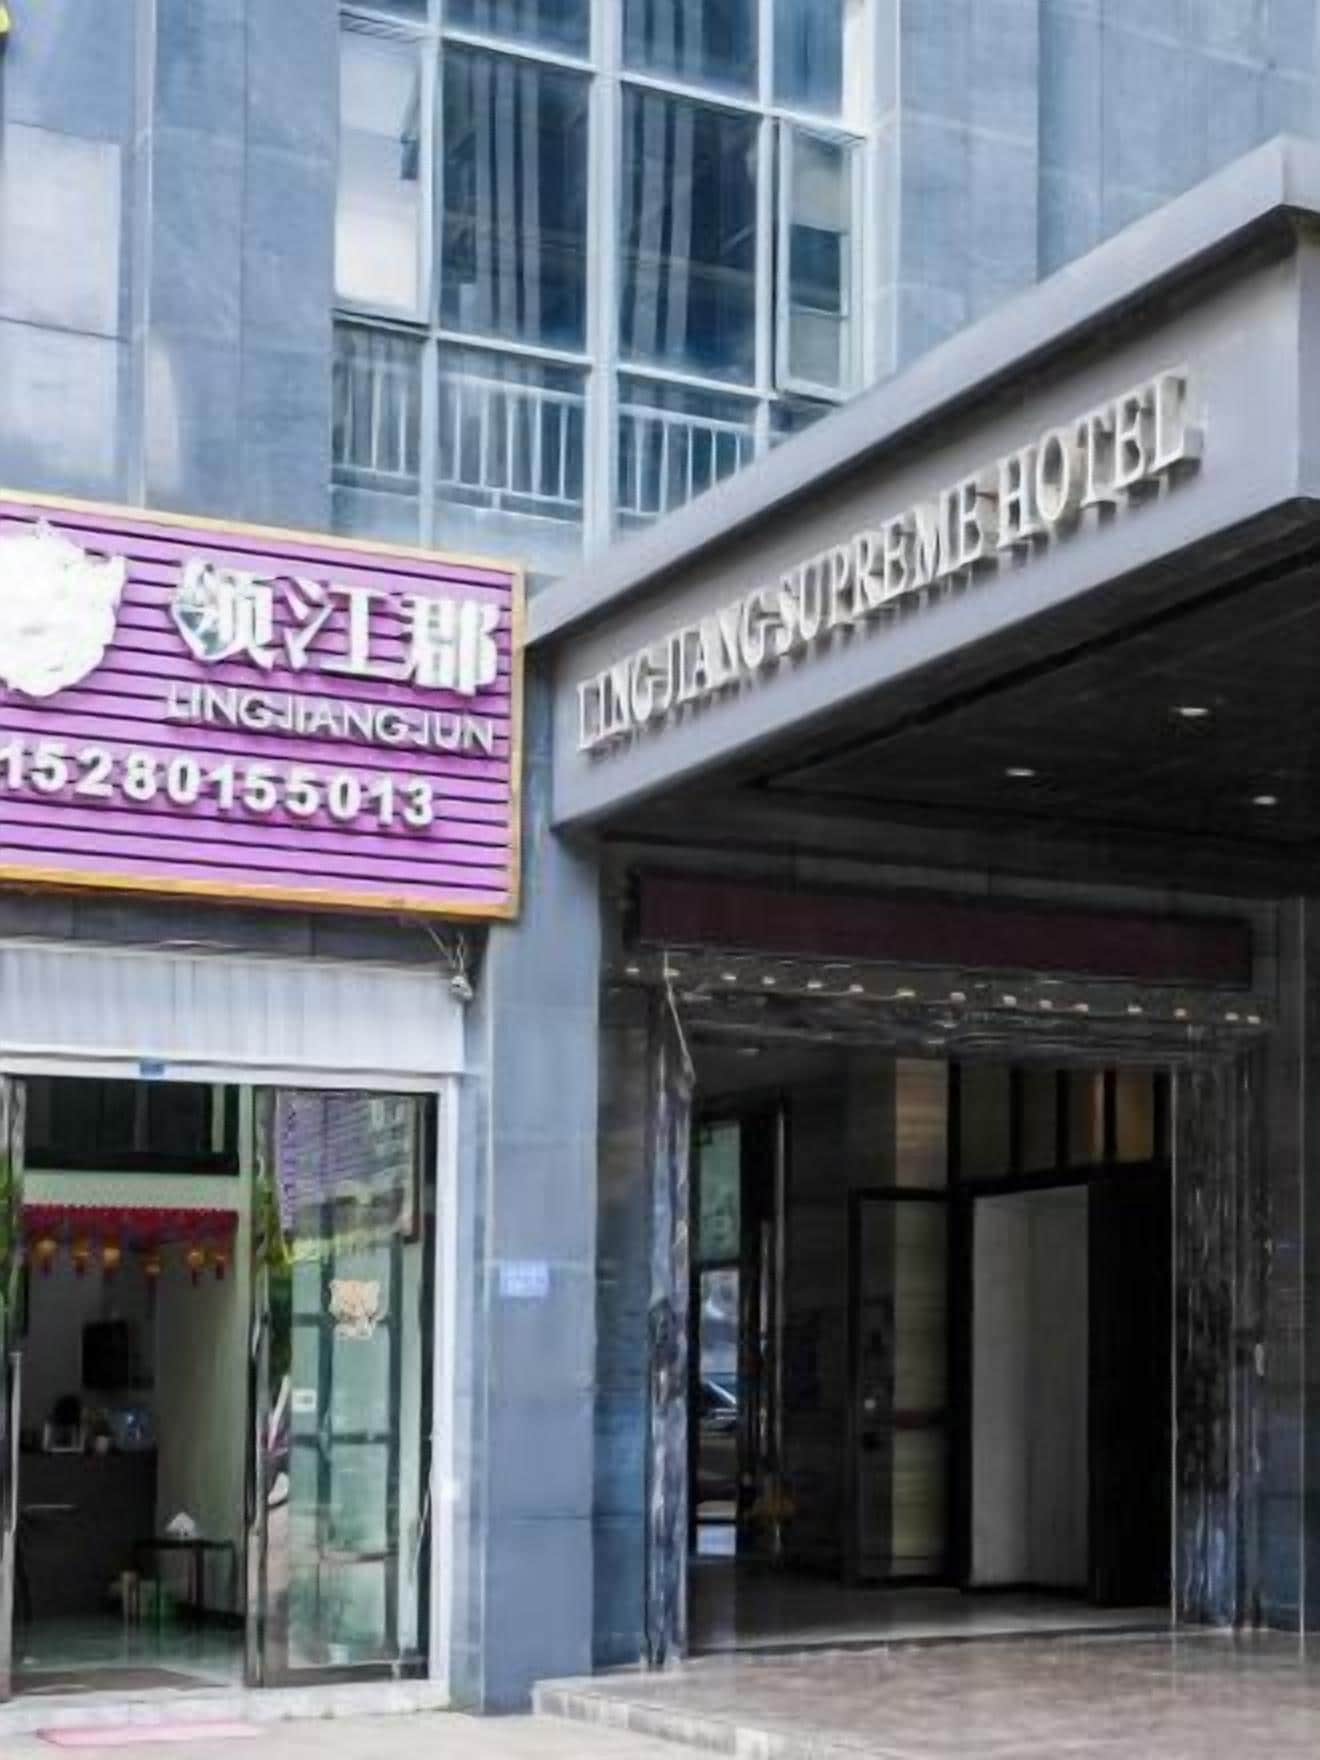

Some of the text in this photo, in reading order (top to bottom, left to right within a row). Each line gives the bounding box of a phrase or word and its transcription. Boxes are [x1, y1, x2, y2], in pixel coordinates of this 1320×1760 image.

[577, 365, 1203, 751] LINGJIANG SUPREME HOTEL
[171, 557, 498, 695] 领江郡
[165, 682, 495, 754] LINGJIANGJUN
[0, 739, 434, 828] 15280155013
